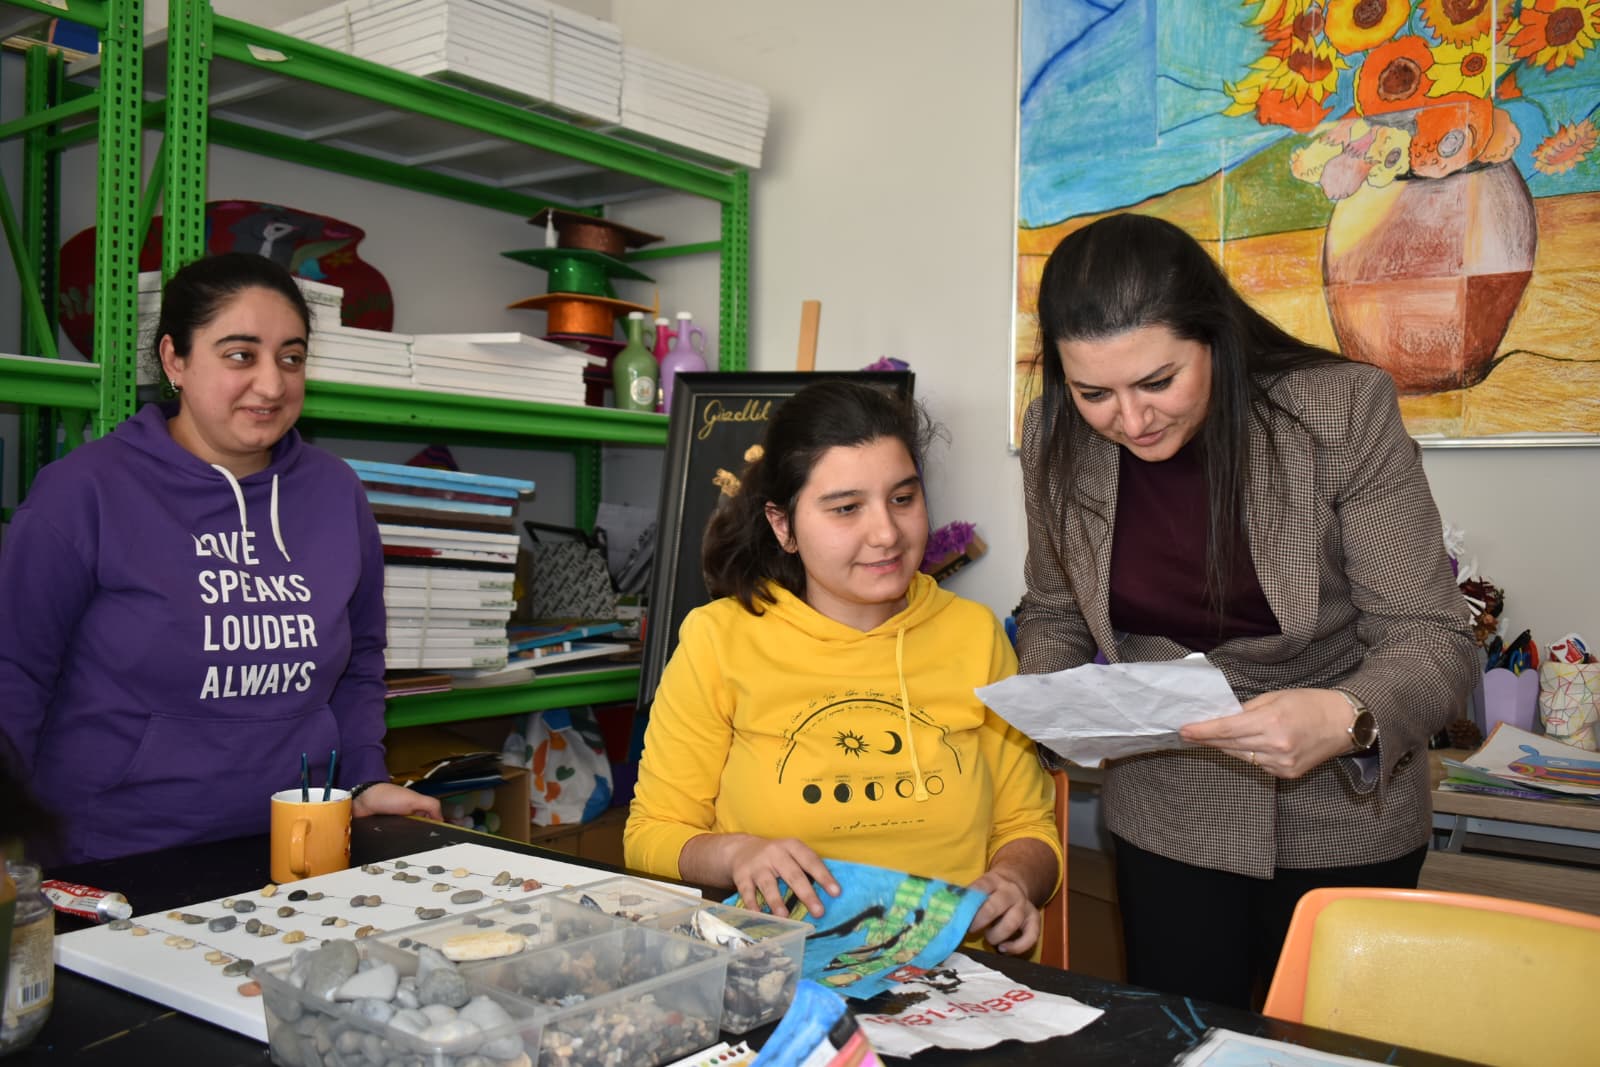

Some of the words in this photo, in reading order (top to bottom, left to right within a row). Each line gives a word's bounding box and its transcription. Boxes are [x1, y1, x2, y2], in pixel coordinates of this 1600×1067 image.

[191, 531, 260, 565] LOVE
[198, 569, 312, 605] SPEAKS
[203, 614, 318, 651] LOUDER
[199, 660, 317, 700] ALWAYS
